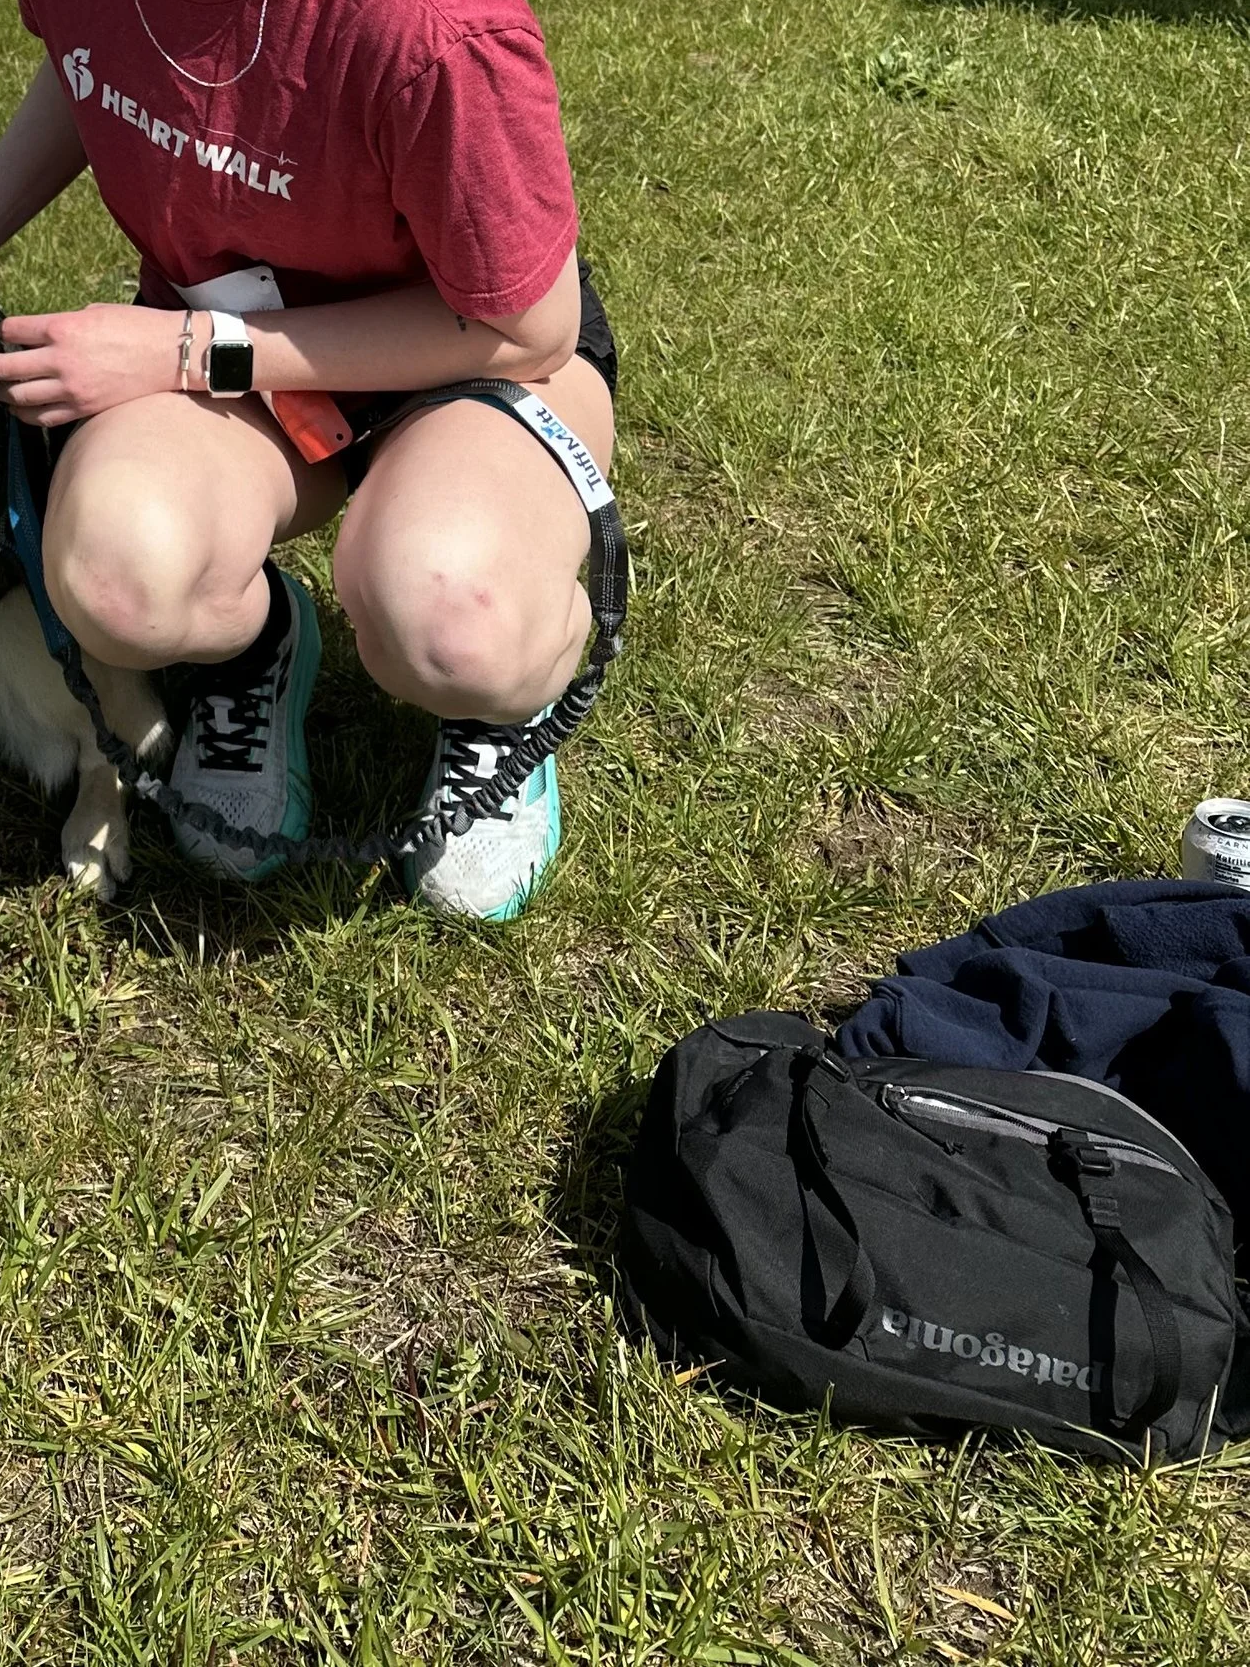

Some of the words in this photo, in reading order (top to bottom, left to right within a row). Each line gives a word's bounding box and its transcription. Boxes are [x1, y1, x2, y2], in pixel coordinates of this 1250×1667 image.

[101, 83, 189, 158] HEART
[195, 139, 294, 201] WALK
[882, 1306, 1104, 1392] patagonia
